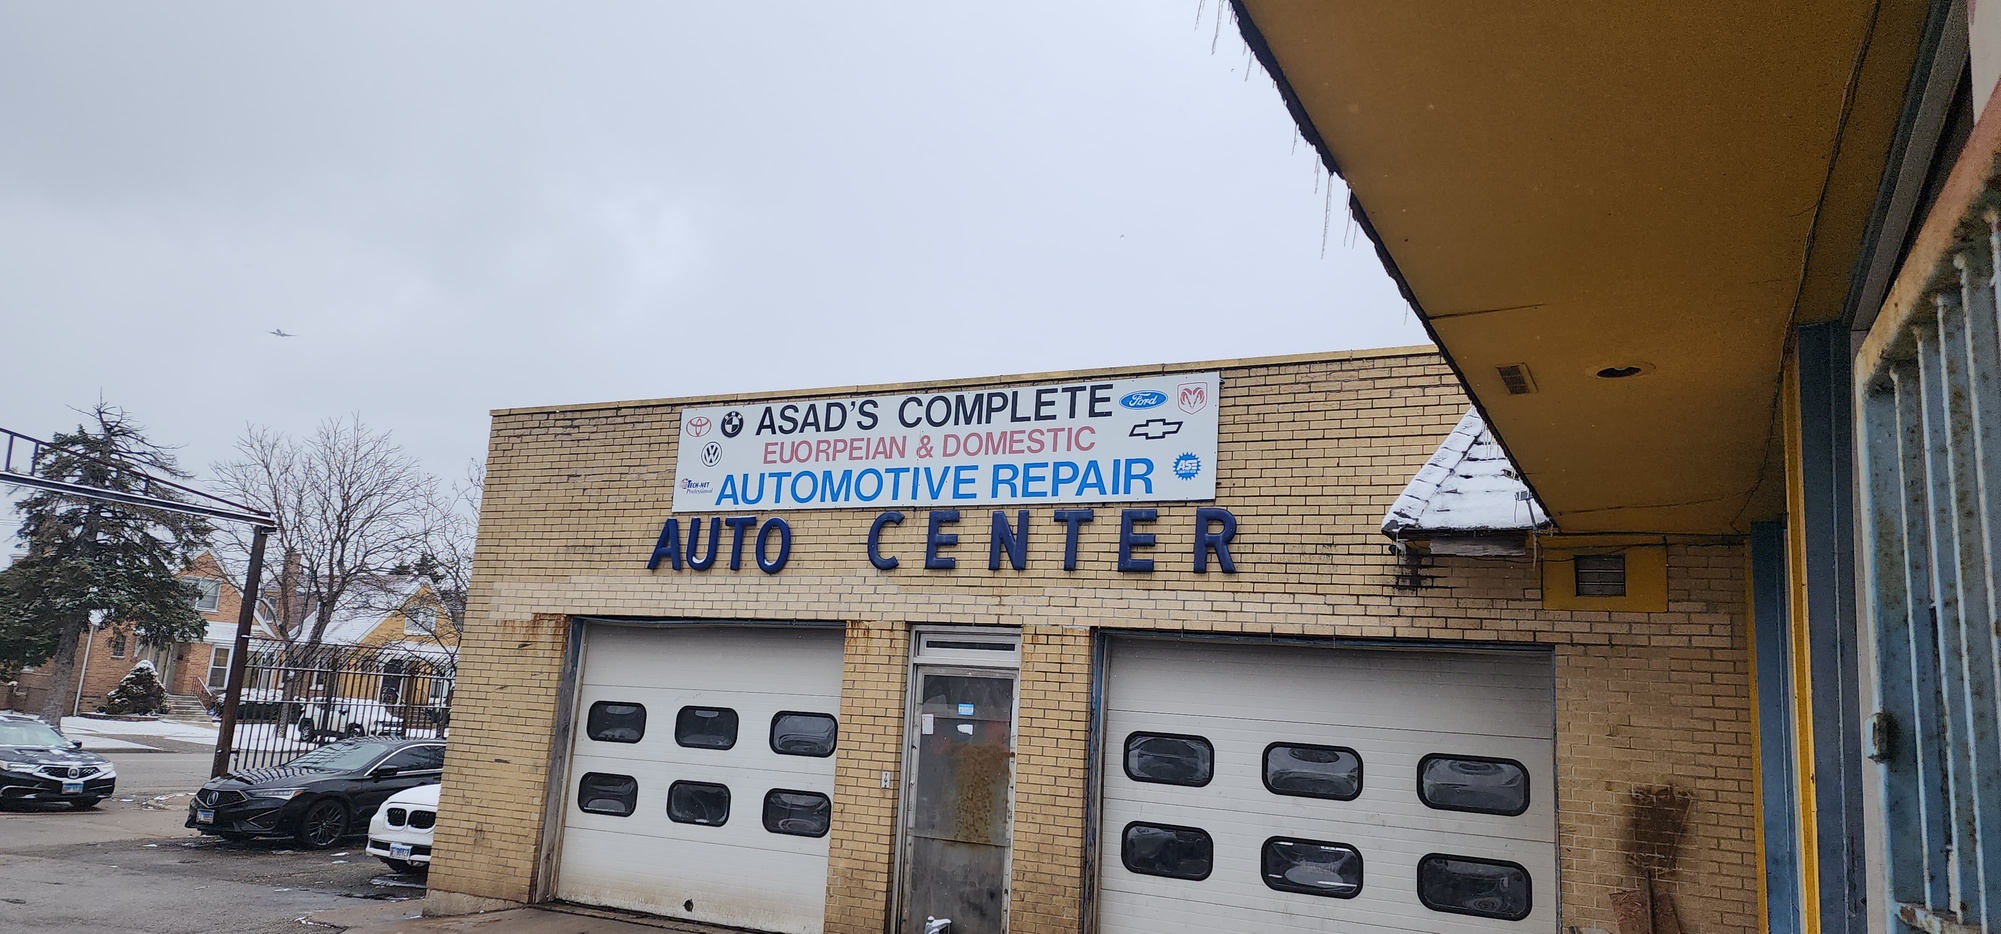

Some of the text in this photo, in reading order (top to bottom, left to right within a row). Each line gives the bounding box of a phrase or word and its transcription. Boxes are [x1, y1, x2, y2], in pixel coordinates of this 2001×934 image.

[756, 384, 1114, 436] ASAD'S COMPLETE
[1128, 393, 1158, 406] Ford
[763, 426, 1096, 464] EUORPEIAN & DOMESTIC
[1176, 459, 1198, 471] ASE
[715, 458, 1154, 506] AUTOMOTIVE REPAIR
[648, 508, 1238, 574] AUTO CENTER
